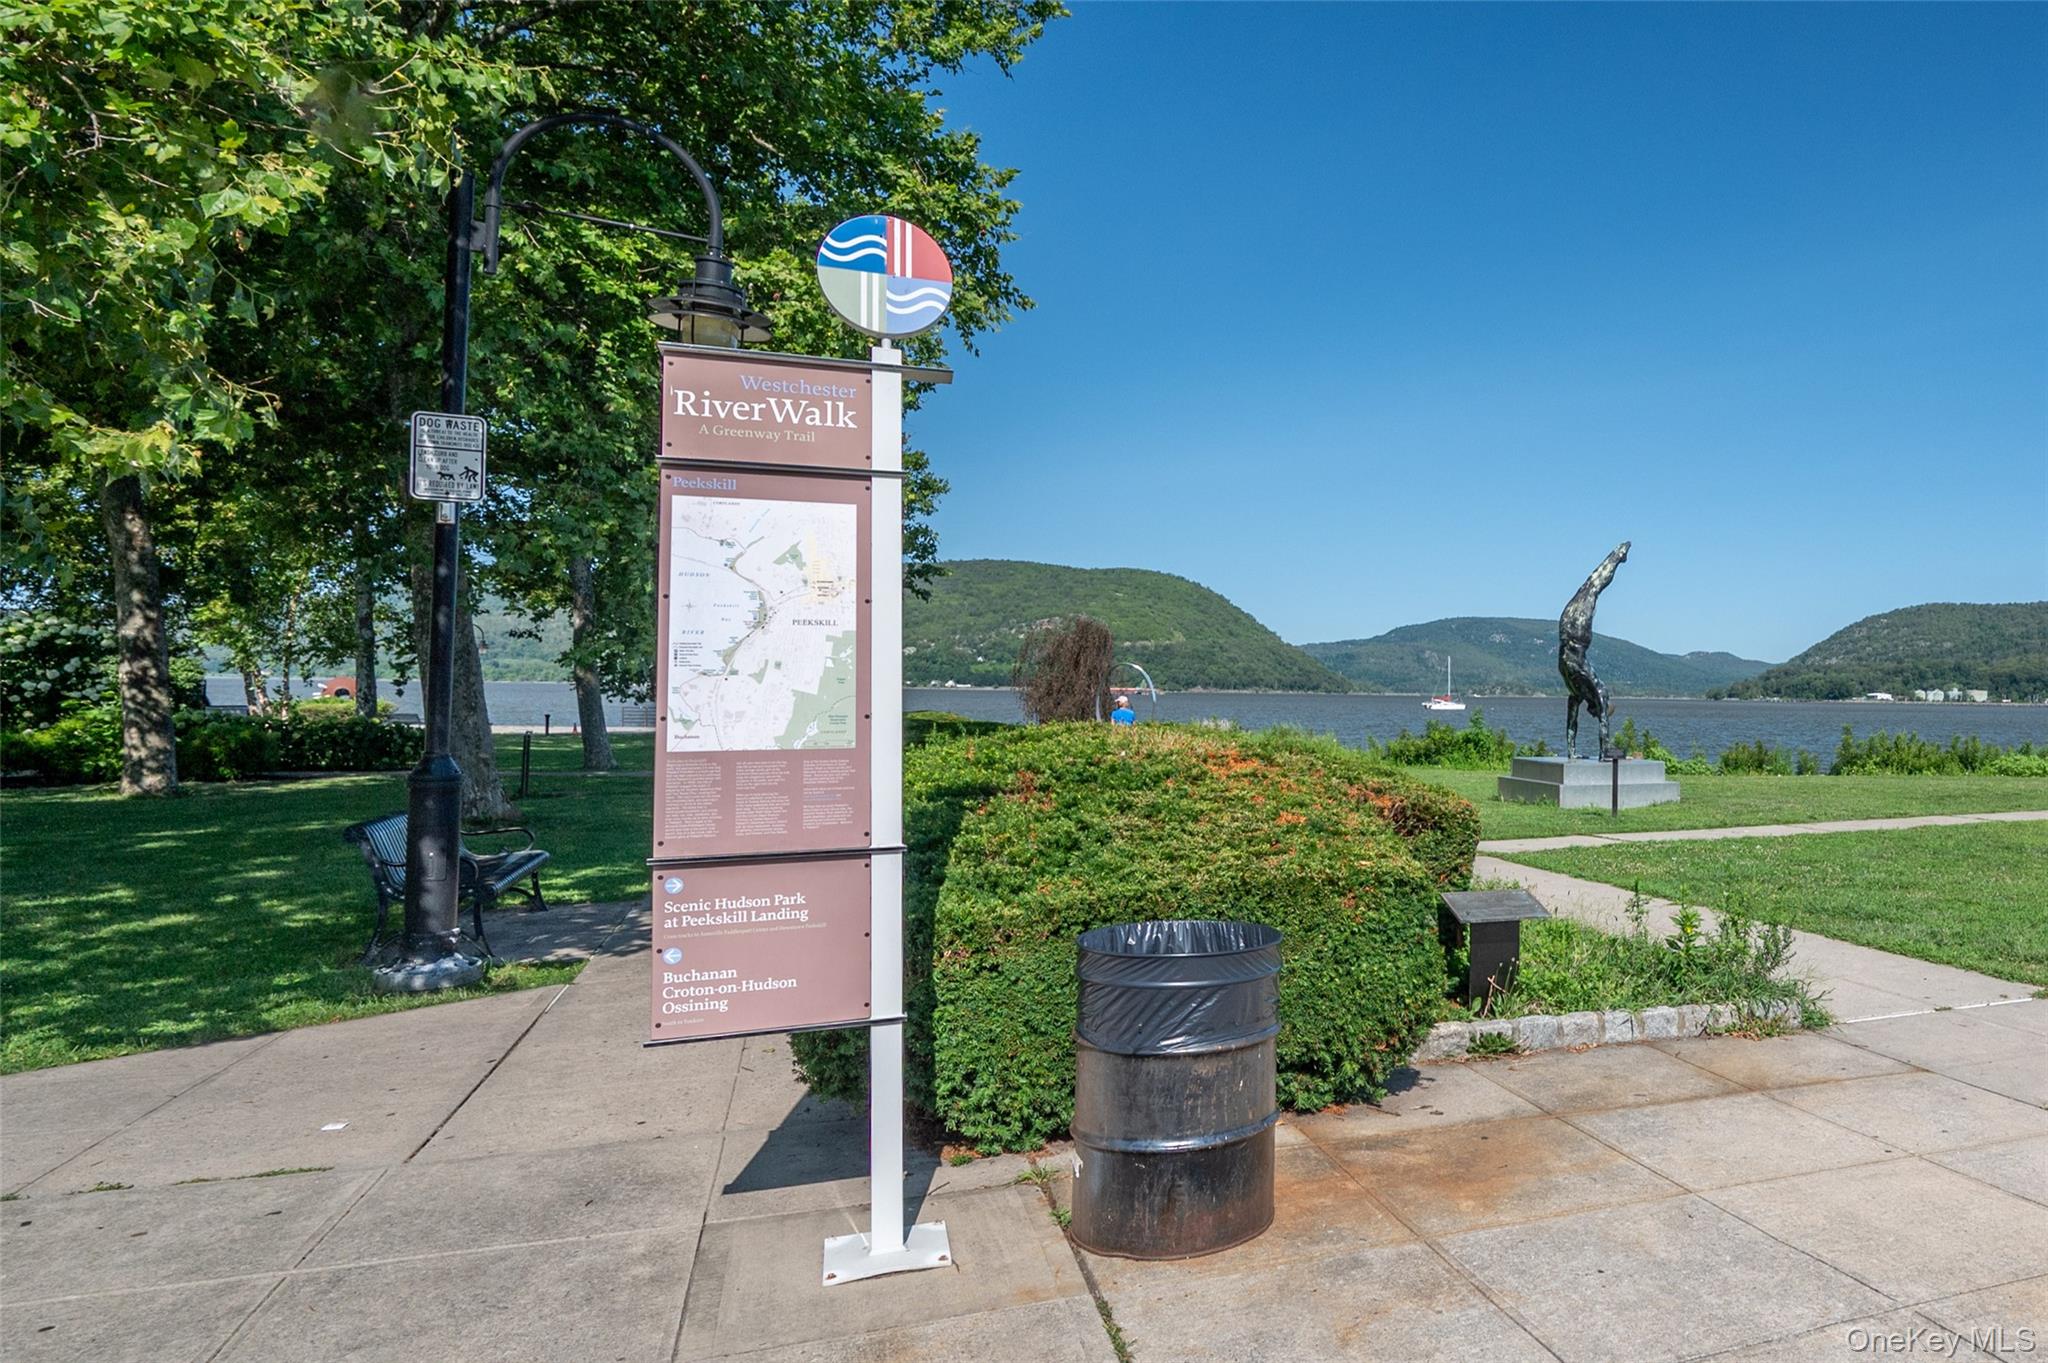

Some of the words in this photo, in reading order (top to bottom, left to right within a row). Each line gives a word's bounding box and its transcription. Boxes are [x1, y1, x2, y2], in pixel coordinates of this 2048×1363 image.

[741, 374, 857, 398] Westchester
[419, 417, 441, 428] DOG
[445, 419, 480, 432] WASTE
[699, 424, 709, 435] A
[713, 425, 781, 442] Greenway
[784, 430, 815, 442] Trail
[429, 480, 455, 488] REQUIRED
[673, 476, 737, 491] Peekskill
[792, 619, 839, 627] PEEKSKILL
[664, 899, 711, 914] Scenic
[715, 896, 770, 910] Hudson
[774, 892, 806, 905] Park
[663, 917, 679, 929] at
[682, 911, 747, 926] Peekskill
[751, 908, 809, 923] Landing
[663, 968, 737, 984] Buchanan
[662, 977, 798, 999] Croton-on-Hudson
[662, 999, 729, 1015] Ossining
